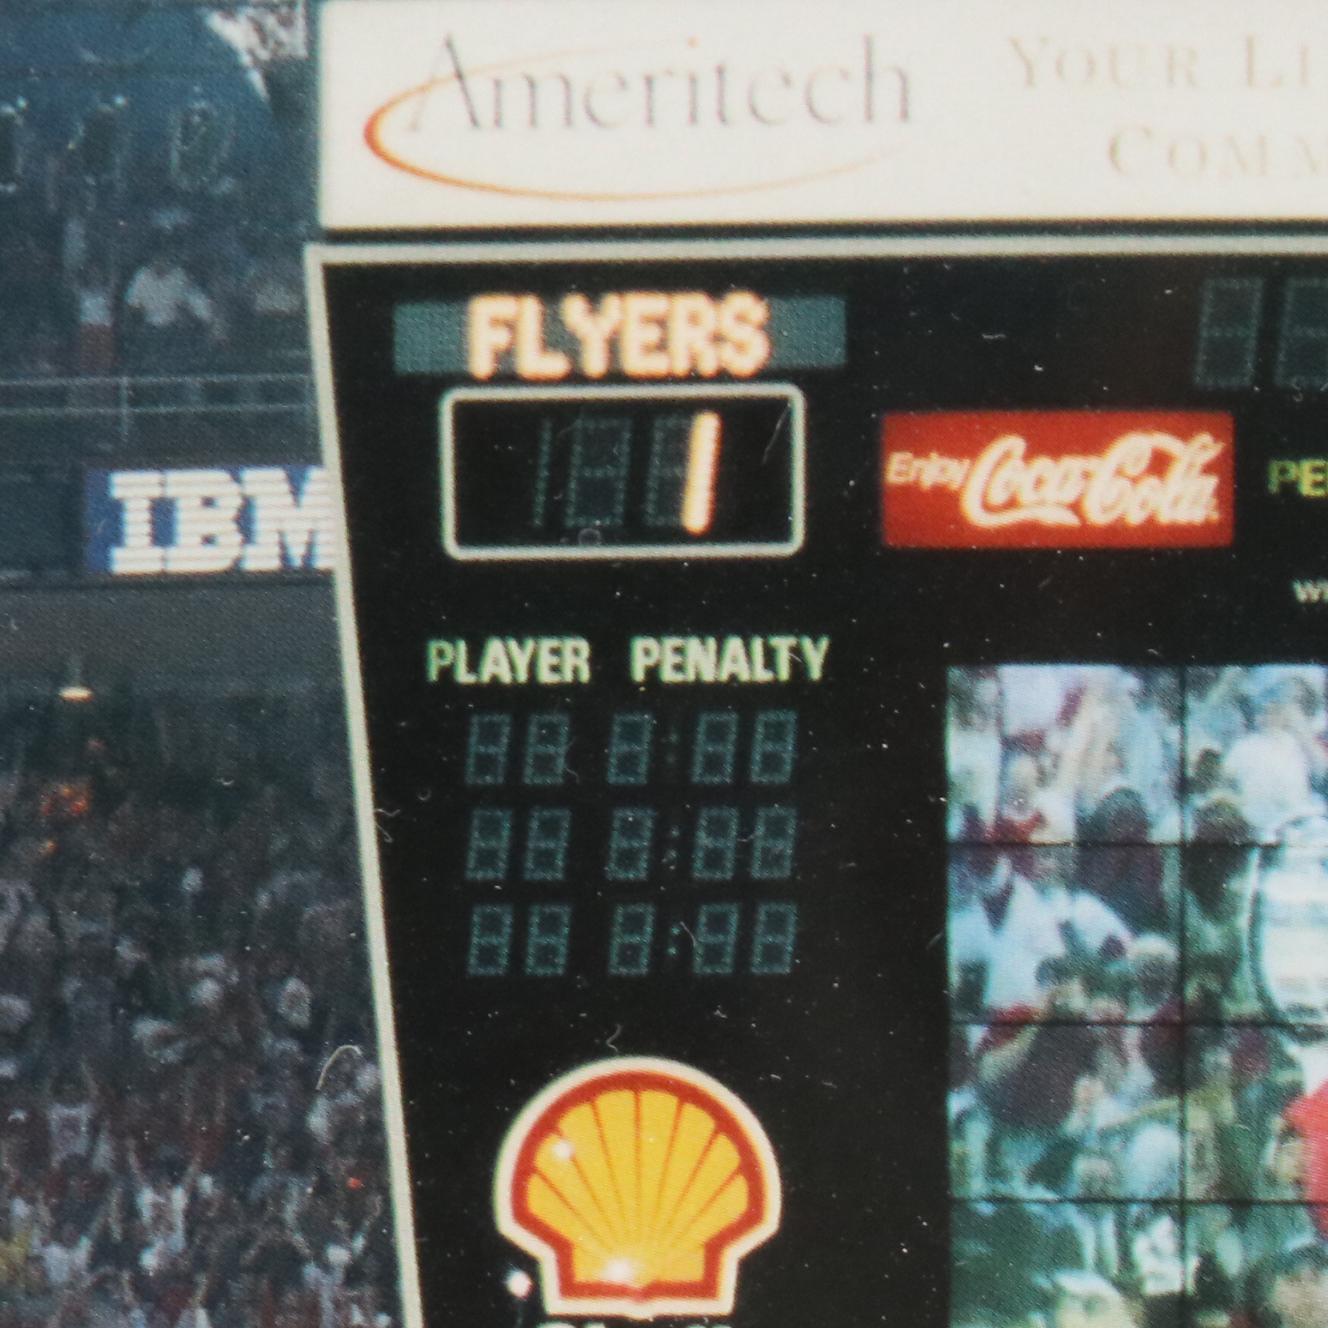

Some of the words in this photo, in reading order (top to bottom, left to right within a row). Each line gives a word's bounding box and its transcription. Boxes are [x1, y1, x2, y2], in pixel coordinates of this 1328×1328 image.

[408, 34, 914, 132] Ameritech
[467, 290, 771, 379] FLYERS
[681, 412, 722, 536] 1
[885, 451, 970, 492] Enjoy
[109, 466, 335, 573] IBM
[427, 636, 591, 685] PLAYER
[630, 636, 829, 684] PENALTY
